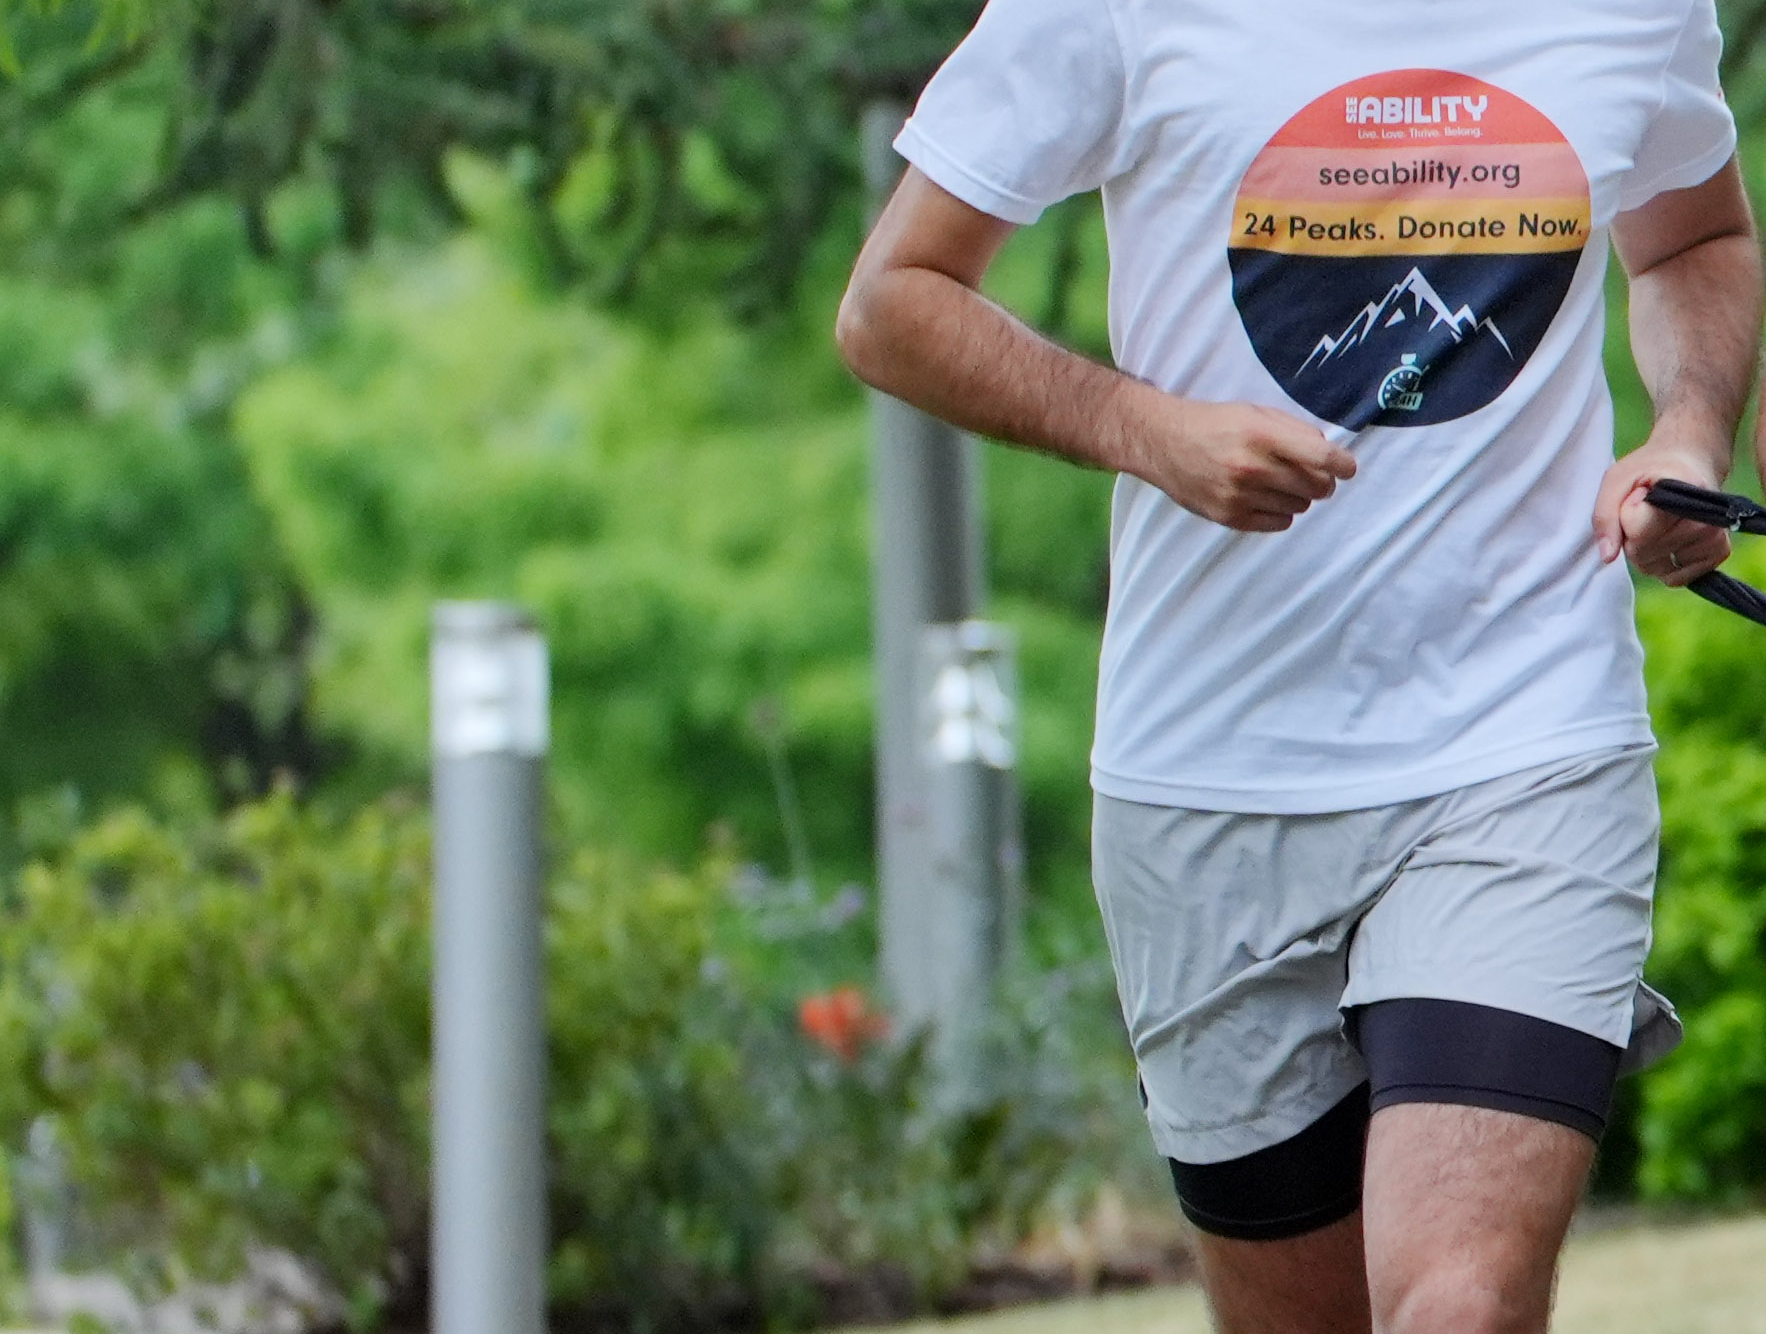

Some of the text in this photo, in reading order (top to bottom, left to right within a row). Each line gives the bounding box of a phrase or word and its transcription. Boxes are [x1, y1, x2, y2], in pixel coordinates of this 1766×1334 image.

[1359, 95, 1488, 124] ABILITY
[1444, 126, 1484, 139] Belong.
[1319, 159, 1520, 189] seeability.org
[1243, 212, 1582, 241] 24 Peaks. Donate Now.
